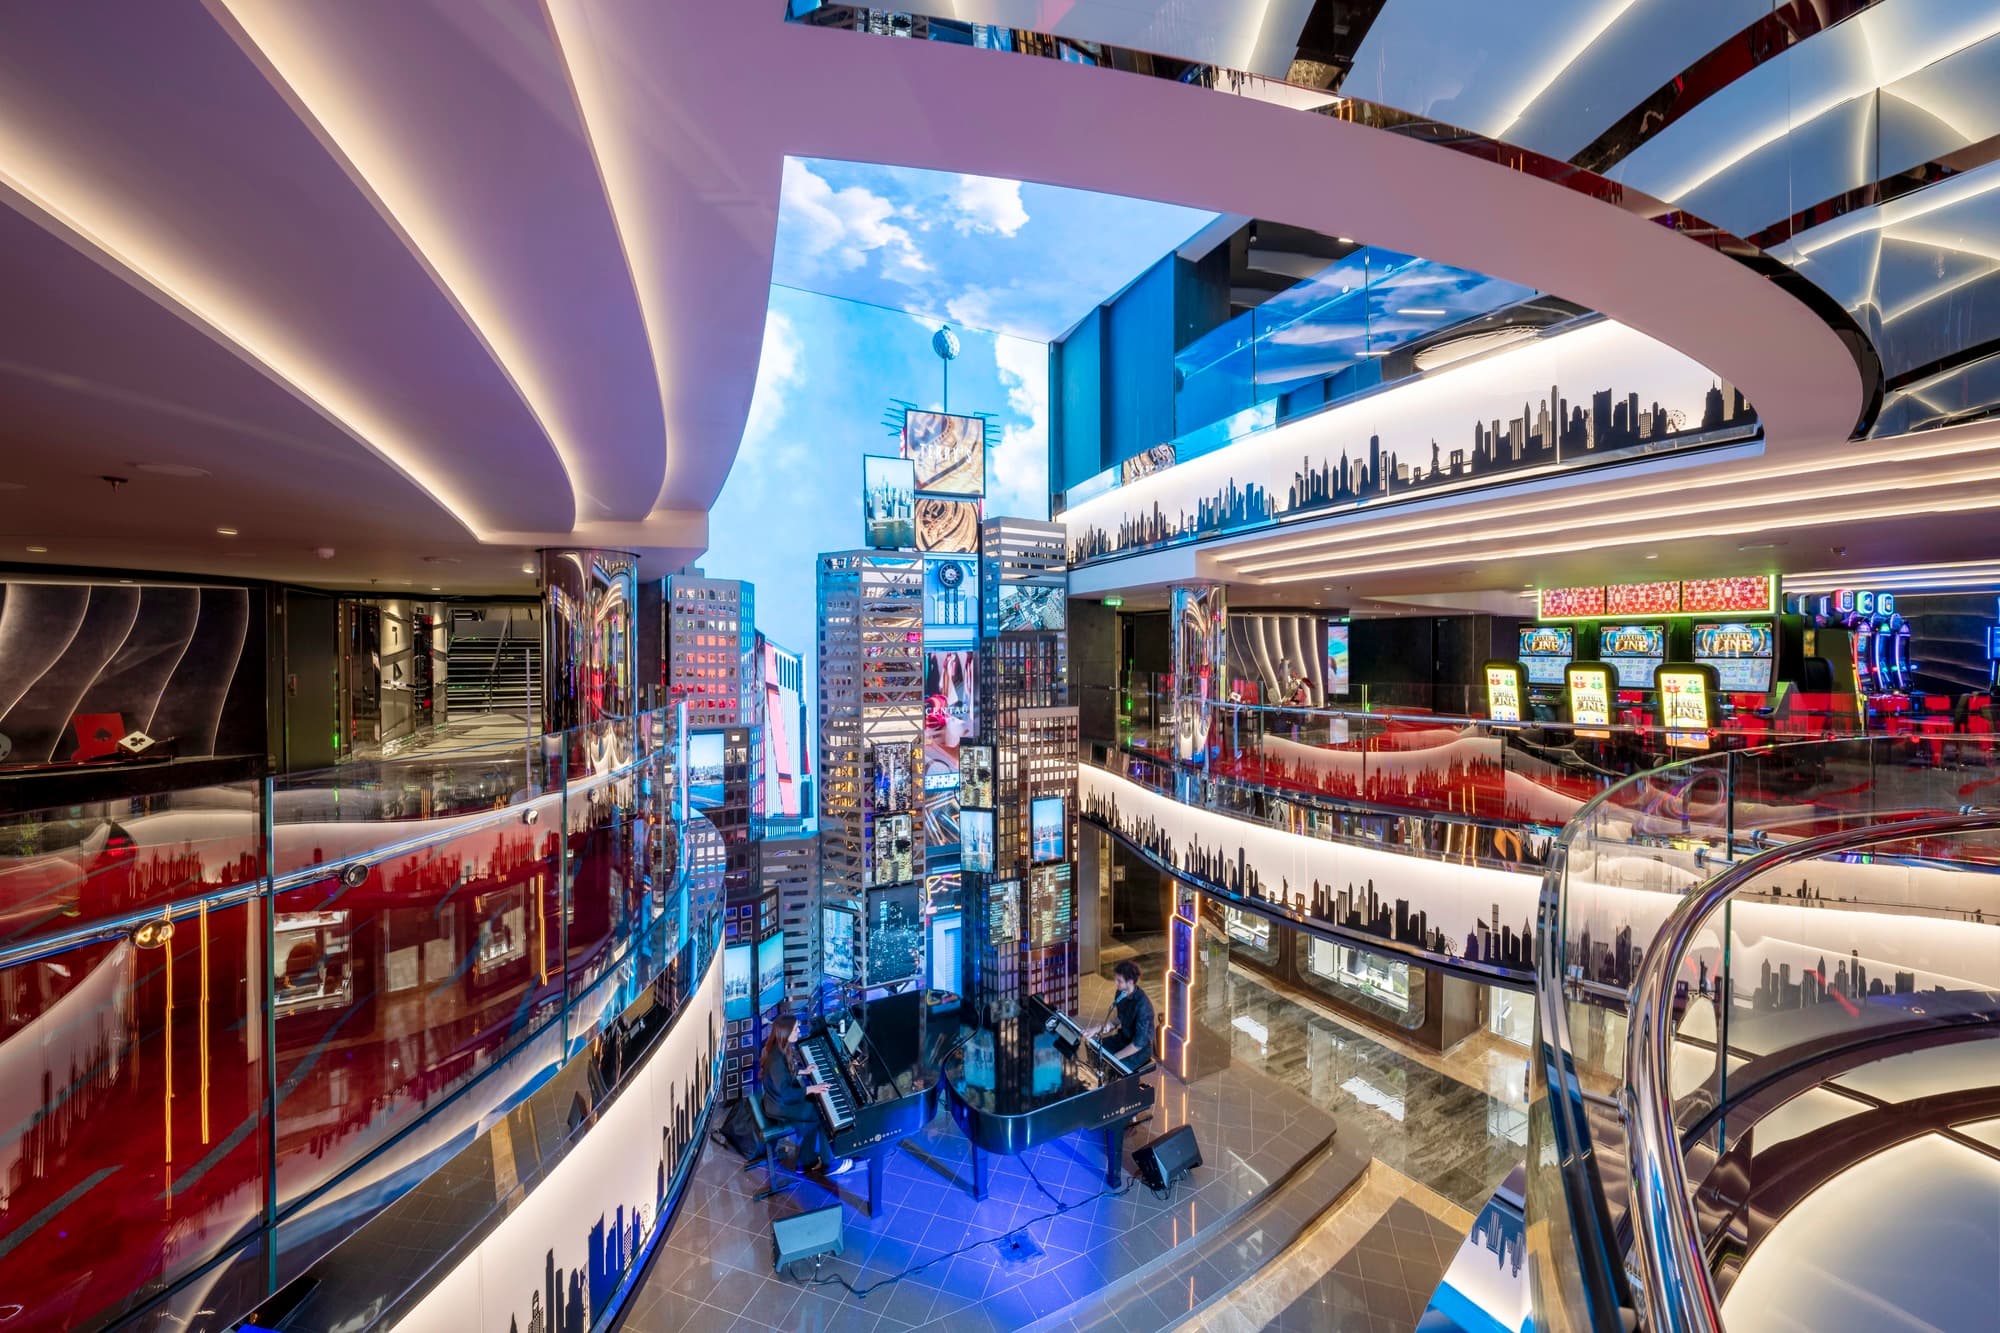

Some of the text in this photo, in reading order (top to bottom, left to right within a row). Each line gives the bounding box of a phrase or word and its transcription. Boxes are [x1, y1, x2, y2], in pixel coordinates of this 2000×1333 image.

[919, 443, 973, 464] TERRY'S
[1532, 640, 1559, 651] LINE
[1615, 640, 1648, 652] LINE
[1712, 639, 1754, 652] LINE
